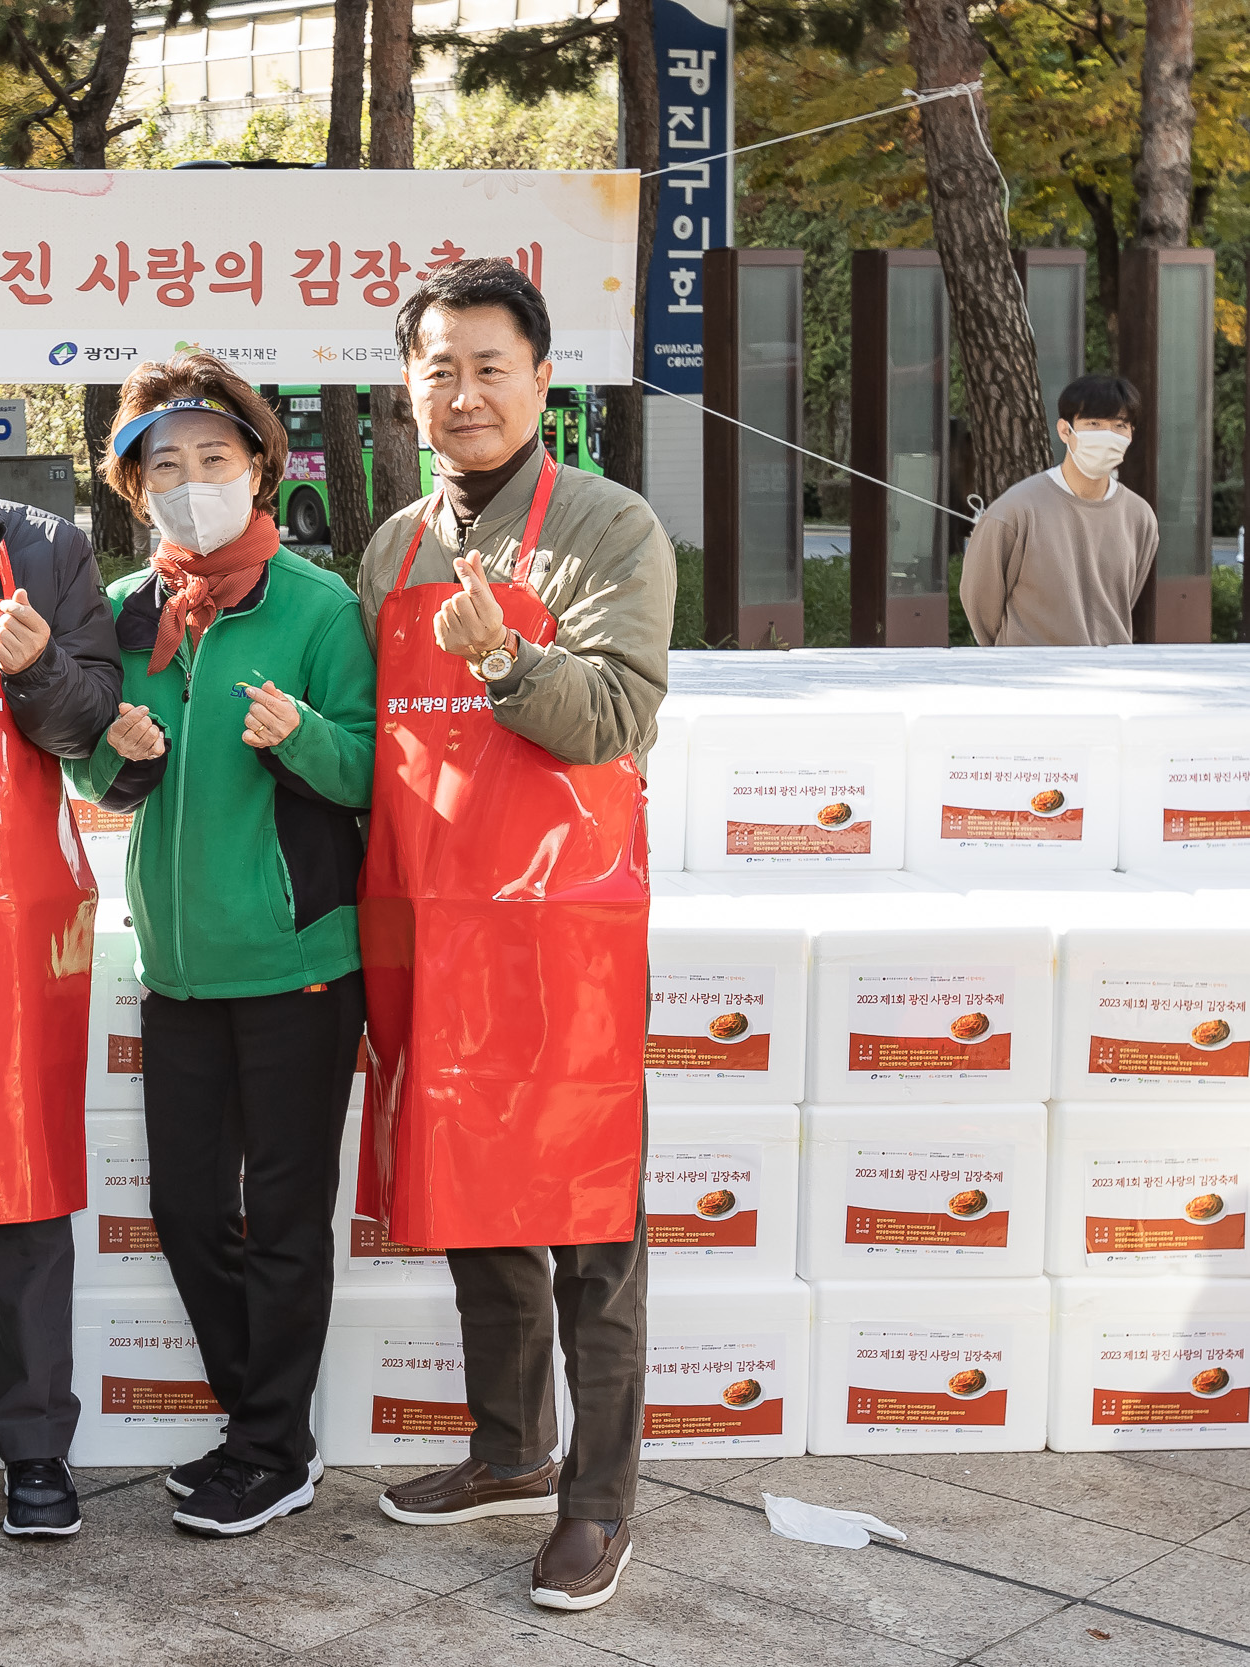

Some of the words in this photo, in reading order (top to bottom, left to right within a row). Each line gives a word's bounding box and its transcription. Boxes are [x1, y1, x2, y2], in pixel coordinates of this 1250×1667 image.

[76, 241, 262, 307] 사랑의
[84, 347, 138, 360] 광진구
[667, 356, 704, 368] COUNCI
[388, 698, 408, 714] 광진
[410, 696, 448, 714] 사랑의
[949, 771, 969, 779] 2023
[969, 771, 992, 781] 제1회
[994, 771, 1013, 782] 광진
[1013, 772, 1041, 782] 사랑의
[1043, 772, 1079, 783] 김장축제
[733, 787, 753, 795] 2023
[753, 786, 777, 796] 제1회
[778, 786, 798, 796] 광진
[799, 786, 827, 796] 사랑의
[829, 786, 865, 796] 김장축제
[116, 996, 138, 1006] 2023
[666, 992, 688, 1004] 광진
[690, 993, 720, 1004] 사랑의
[723, 993, 764, 1005] 김장축제
[856, 995, 879, 1003] 2023
[879, 994, 906, 1005] 제1회
[908, 994, 929, 1005] 광진
[930, 994, 961, 1005] 사랑의
[964, 994, 1005, 1005] 김장축제
[1098, 998, 1121, 1007] 2023
[1122, 998, 1148, 1009] 제1회
[1150, 999, 1171, 1010] 광진
[1172, 1000, 1204, 1011] 사랑의
[1206, 1000, 1247, 1012] 김장축제
[105, 1177, 126, 1186] 2023
[654, 1171, 674, 1183] 광진
[676, 1171, 707, 1182] 사랑의
[710, 1171, 751, 1182] 김장축제
[855, 1169, 877, 1177] 2023
[878, 1169, 905, 1180] 제1회
[907, 1169, 928, 1181] 광진
[929, 1170, 960, 1181] 사랑의
[963, 1171, 1004, 1182] 김장축제
[1091, 1179, 1114, 1187] 2023
[1115, 1177, 1141, 1188] 제1회
[1143, 1176, 1163, 1188] 광진
[1165, 1176, 1196, 1187] 사랑의
[1198, 1174, 1239, 1186] 김장축제
[108, 1338, 131, 1346] 2023
[132, 1337, 159, 1348] 제1회
[161, 1337, 183, 1349] 광진
[856, 1350, 879, 1358] 2023
[879, 1349, 905, 1360] 제1회
[907, 1350, 928, 1361] 광진
[929, 1350, 960, 1361] 사랑의
[963, 1350, 1002, 1362] 김장축제
[1100, 1351, 1122, 1359] 2023
[1123, 1350, 1149, 1360] 제1회
[1151, 1350, 1171, 1361] 광진
[1172, 1349, 1203, 1361] 사랑의
[1205, 1349, 1245, 1360] 김장축제
[381, 1358, 404, 1367] 2023
[405, 1358, 432, 1370] 제1회
[433, 1359, 455, 1371] 광진
[651, 1363, 677, 1374] 제1회
[679, 1362, 700, 1374] 광진
[702, 1361, 733, 1373] 사랑의
[736, 1360, 776, 1372] 김장축제
